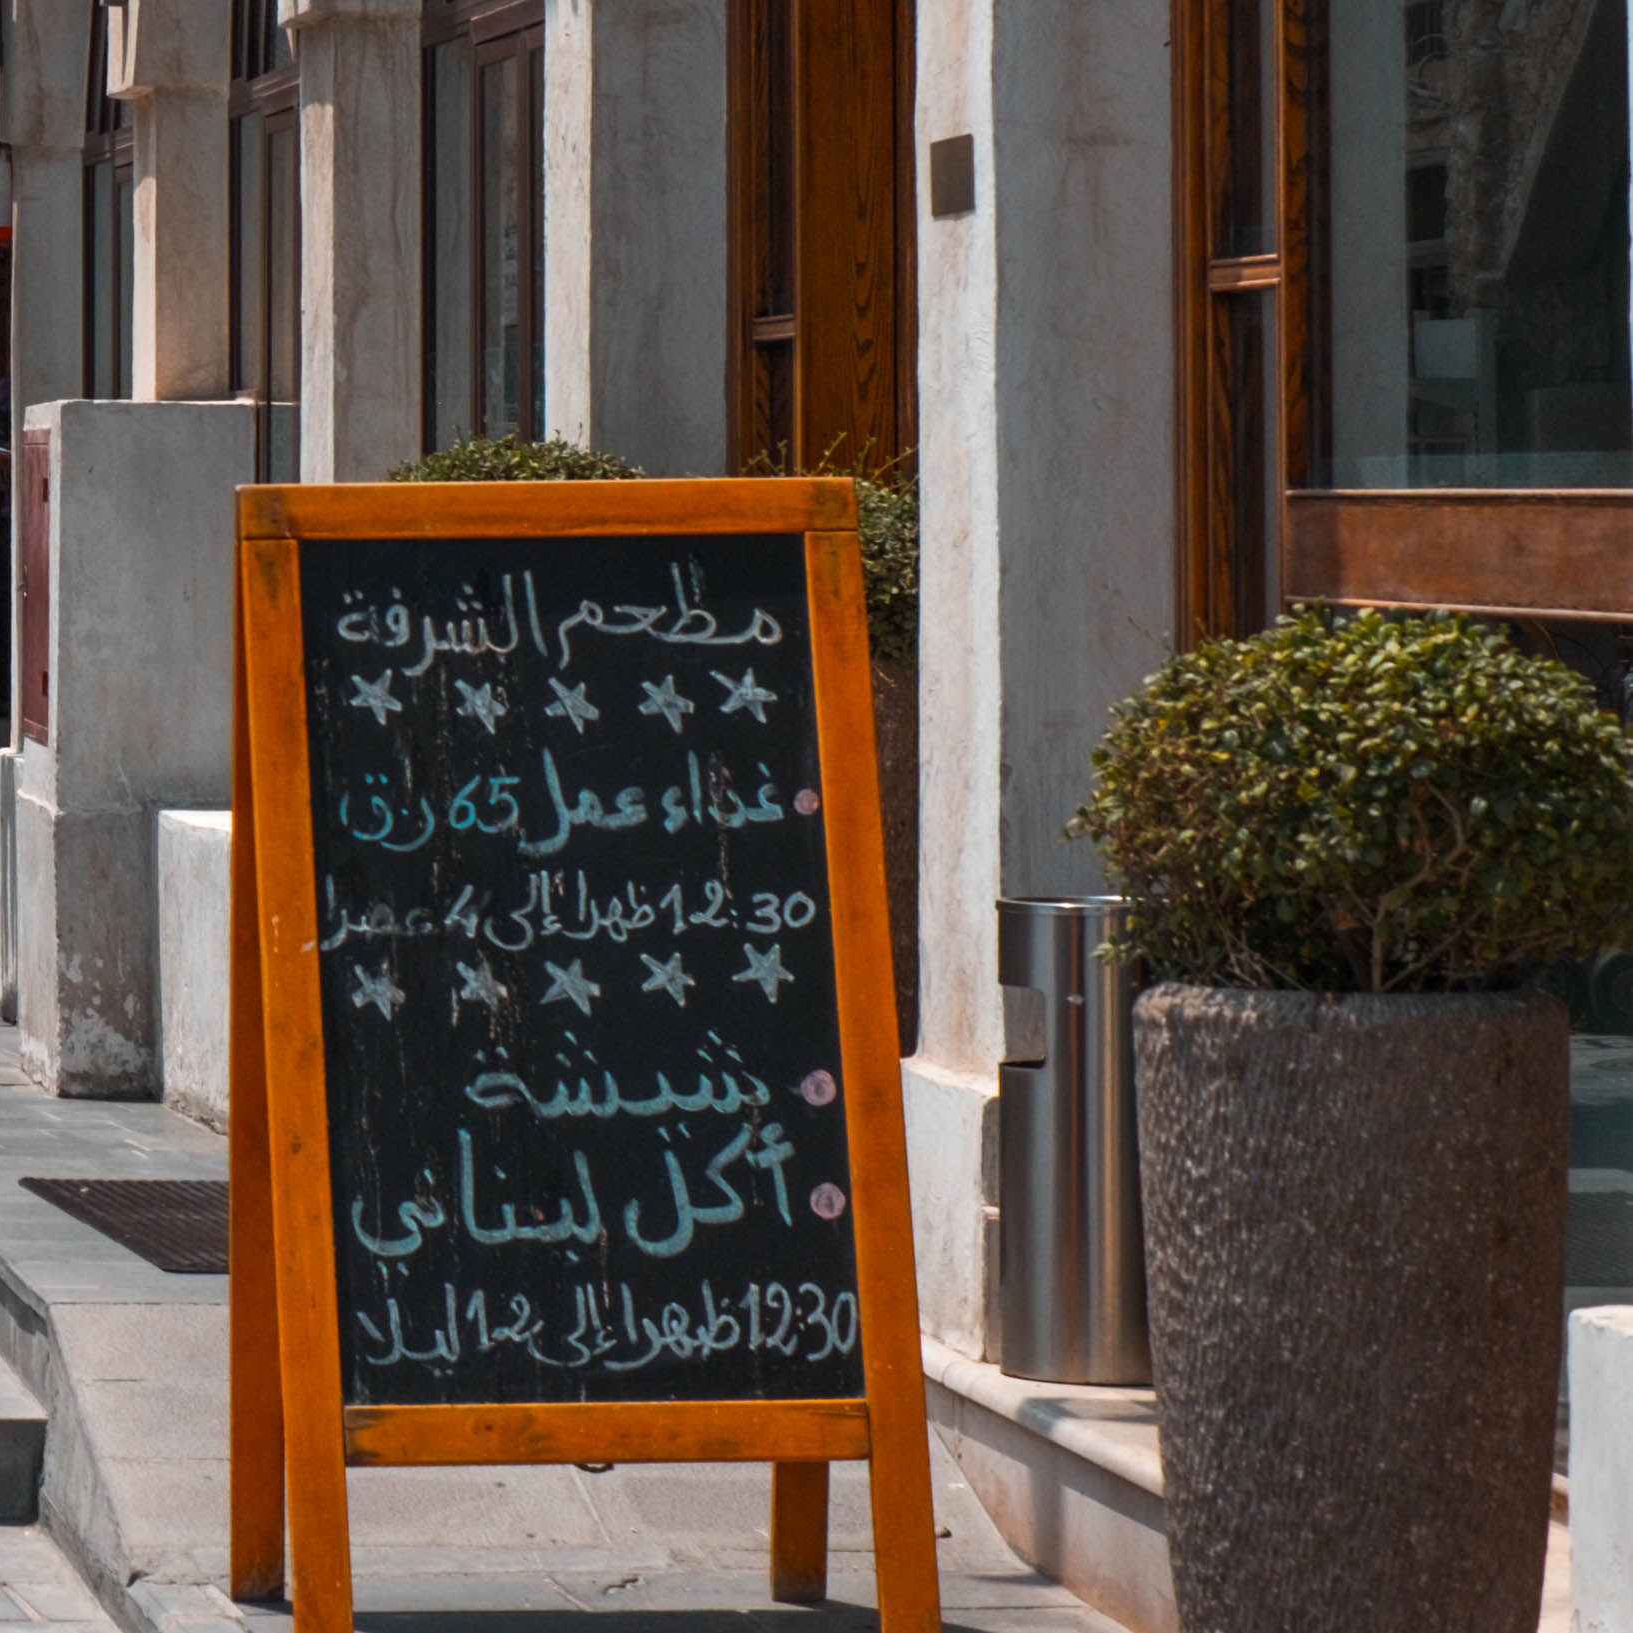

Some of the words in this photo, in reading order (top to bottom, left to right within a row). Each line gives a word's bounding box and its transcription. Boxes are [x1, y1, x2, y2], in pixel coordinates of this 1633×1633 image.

[337, 570, 548, 677] الشرفة
[558, 562, 783, 670] مطعم
[448, 773, 522, 834] 65
[518, 746, 647, 855] عمل
[660, 749, 785, 834] غداء
[465, 1029, 771, 1140] شيشة
[351, 1128, 601, 1277] لبناني
[623, 1121, 796, 1258] أكل
